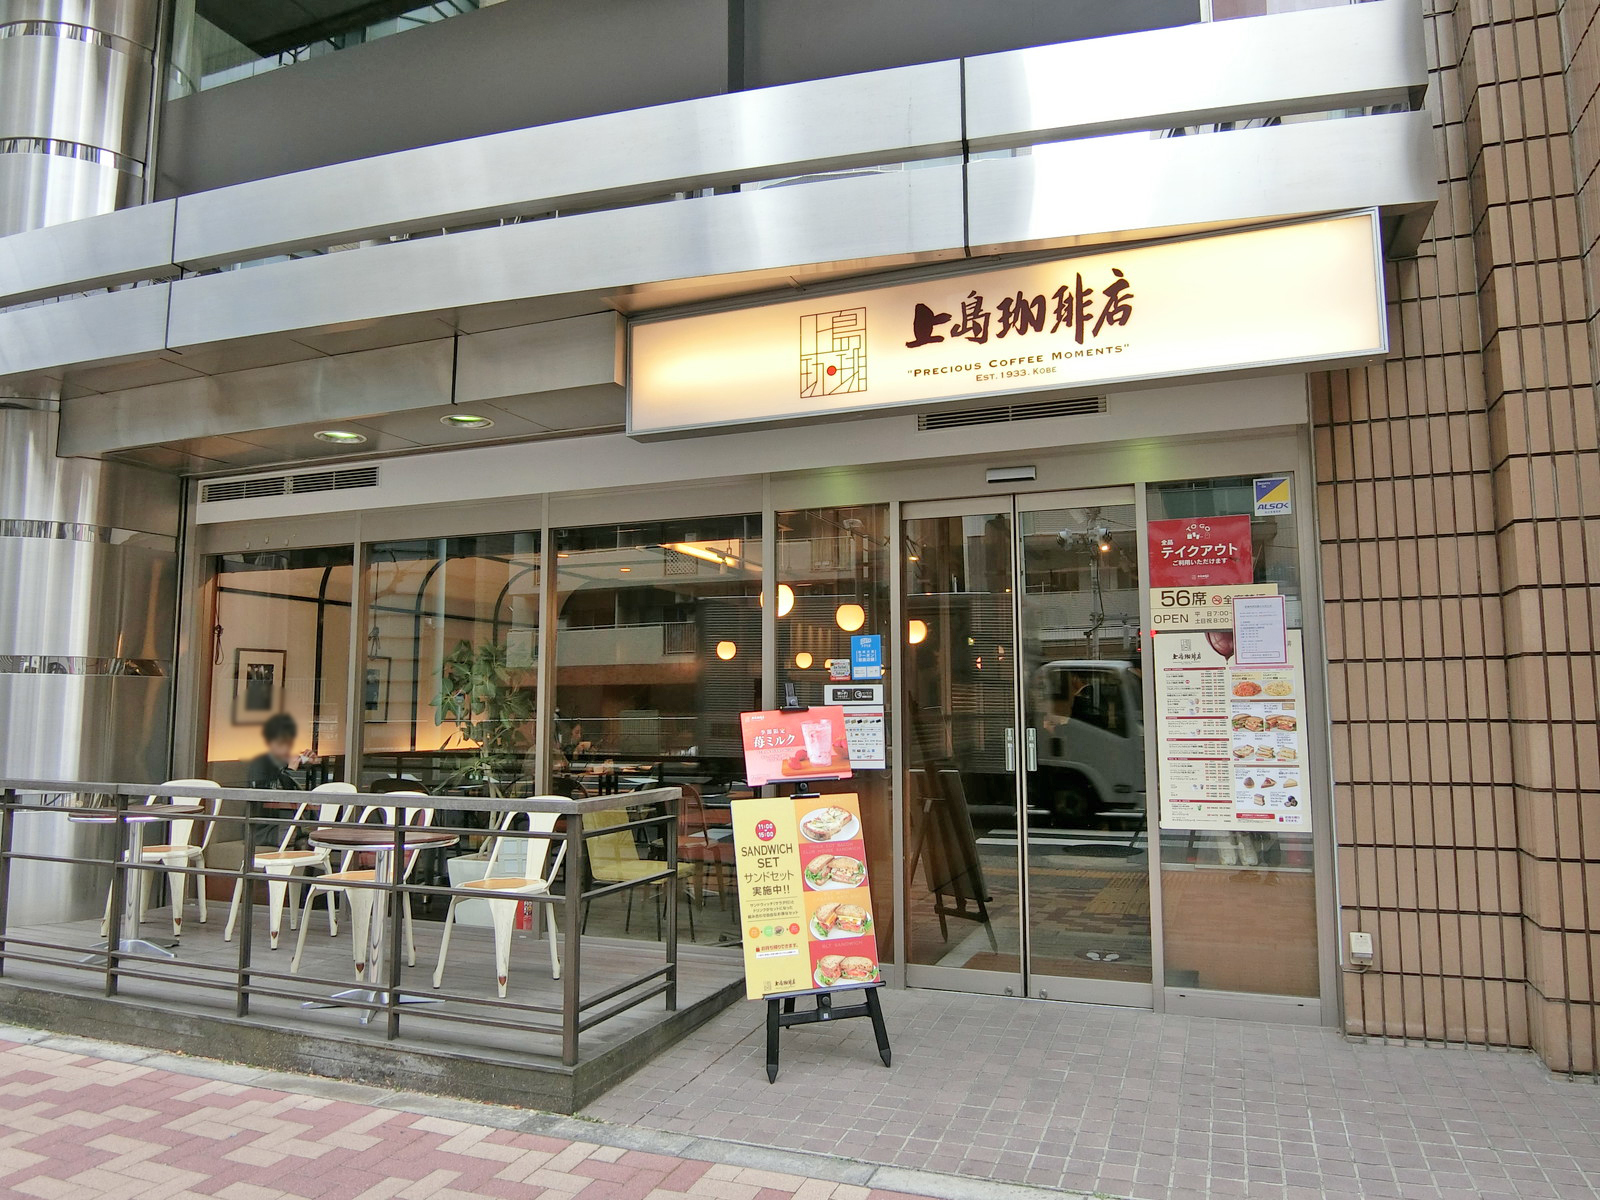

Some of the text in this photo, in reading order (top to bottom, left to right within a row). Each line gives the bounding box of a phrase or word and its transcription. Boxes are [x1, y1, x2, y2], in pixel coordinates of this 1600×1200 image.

[905, 268, 1135, 349] 上島珈琲店
[988, 353, 1044, 369] COFFEE
[1032, 365, 1057, 376] KOBE
[1257, 502, 1289, 510] ALSOK
[1185, 523, 1211, 533] TO GO
[1160, 542, 1238, 559] テイクアウト
[1172, 557, 1228, 567] ご利用いただけます
[1160, 589, 1207, 607] 56席
[1153, 613, 1189, 625] OPEN
[753, 733, 796, 749] 苺ミルク
[741, 843, 793, 857] SANDWICH
[757, 857, 780, 868] SET
[744, 870, 794, 884] サンドセット
